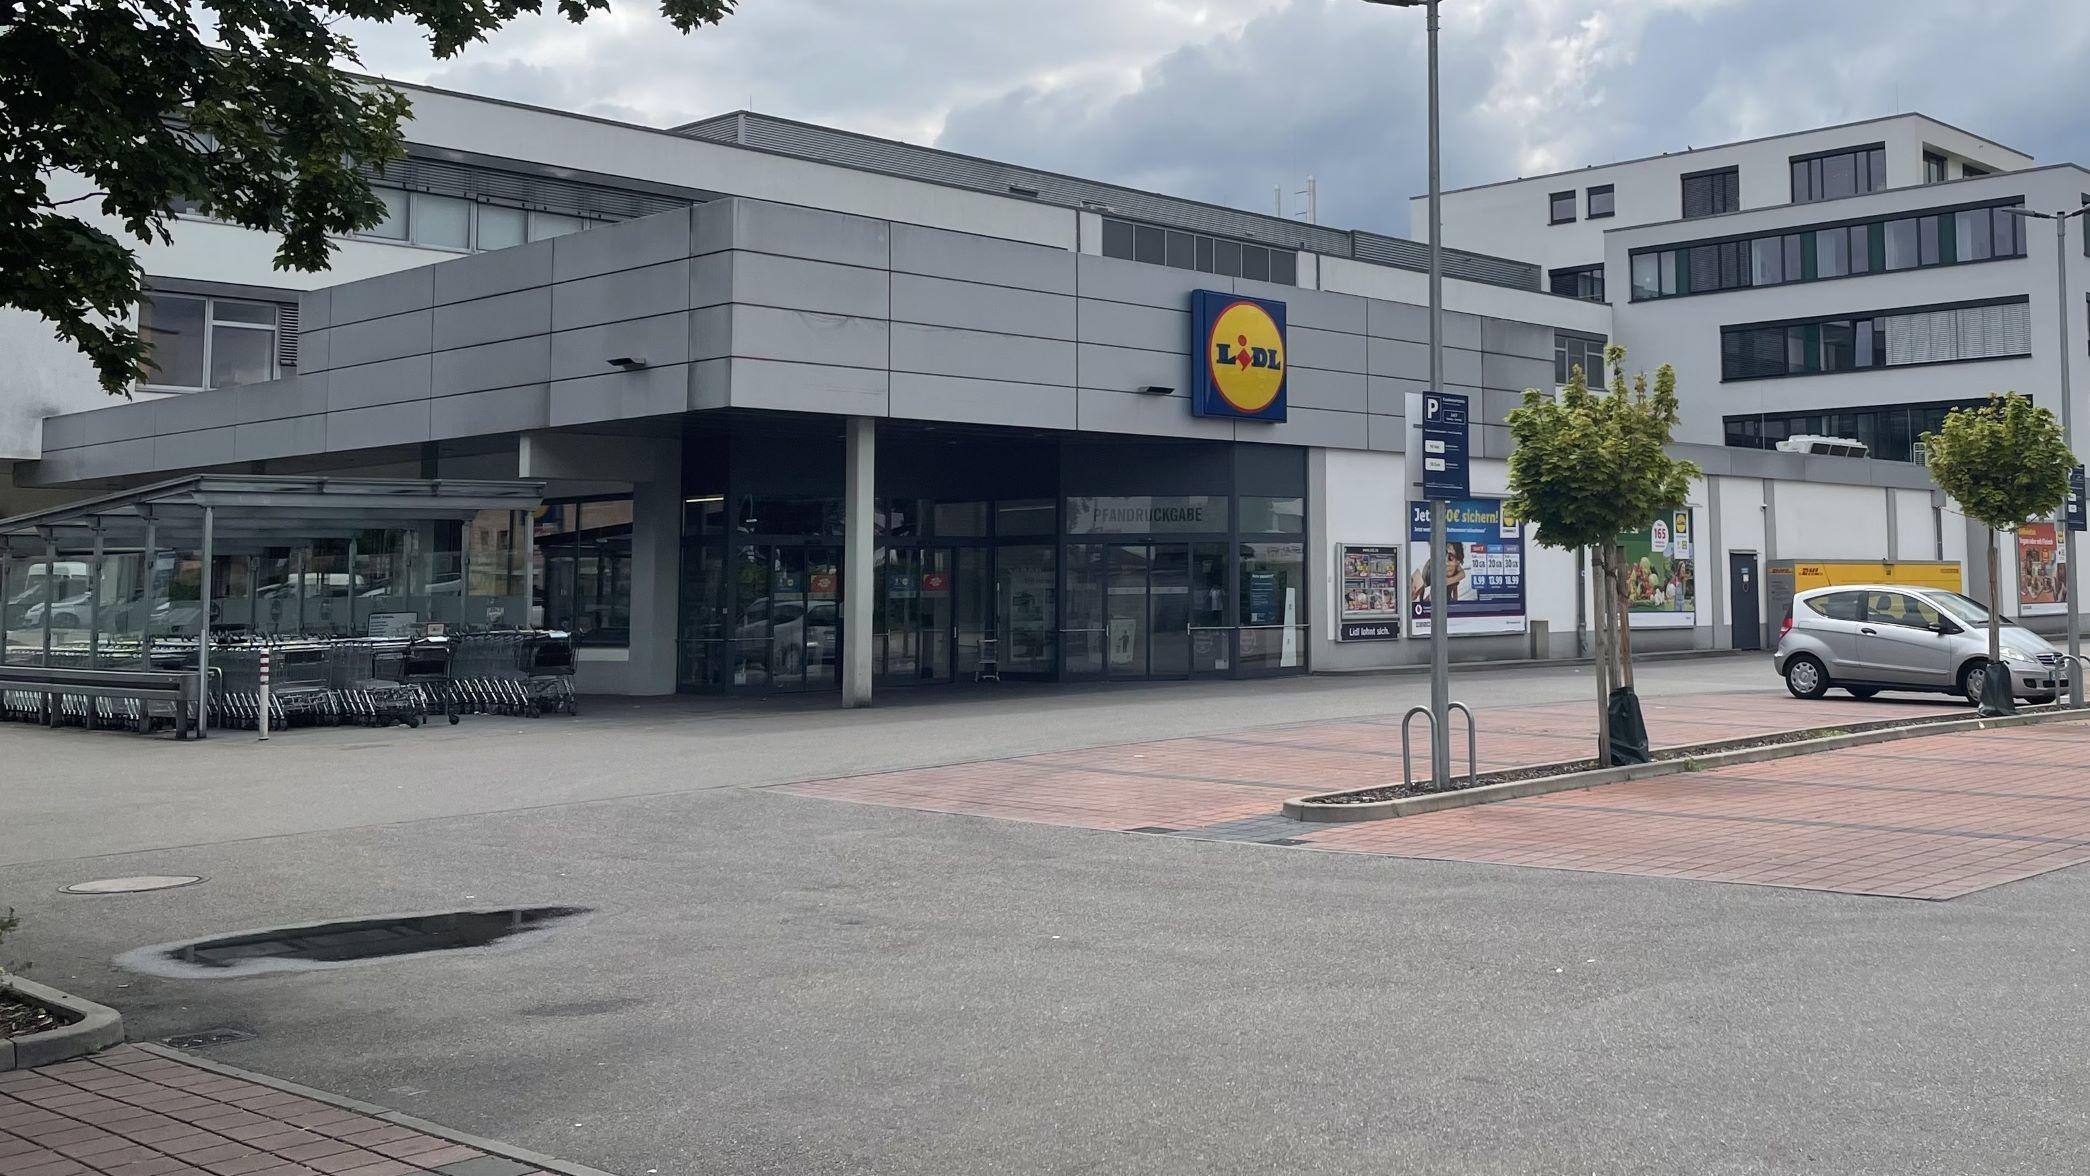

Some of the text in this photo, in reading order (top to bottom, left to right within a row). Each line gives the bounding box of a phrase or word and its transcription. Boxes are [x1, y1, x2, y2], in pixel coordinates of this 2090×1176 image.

[1427, 398, 1439, 419] P
[1462, 509, 1499, 524] sichern!
[1654, 527, 1666, 540] 165
